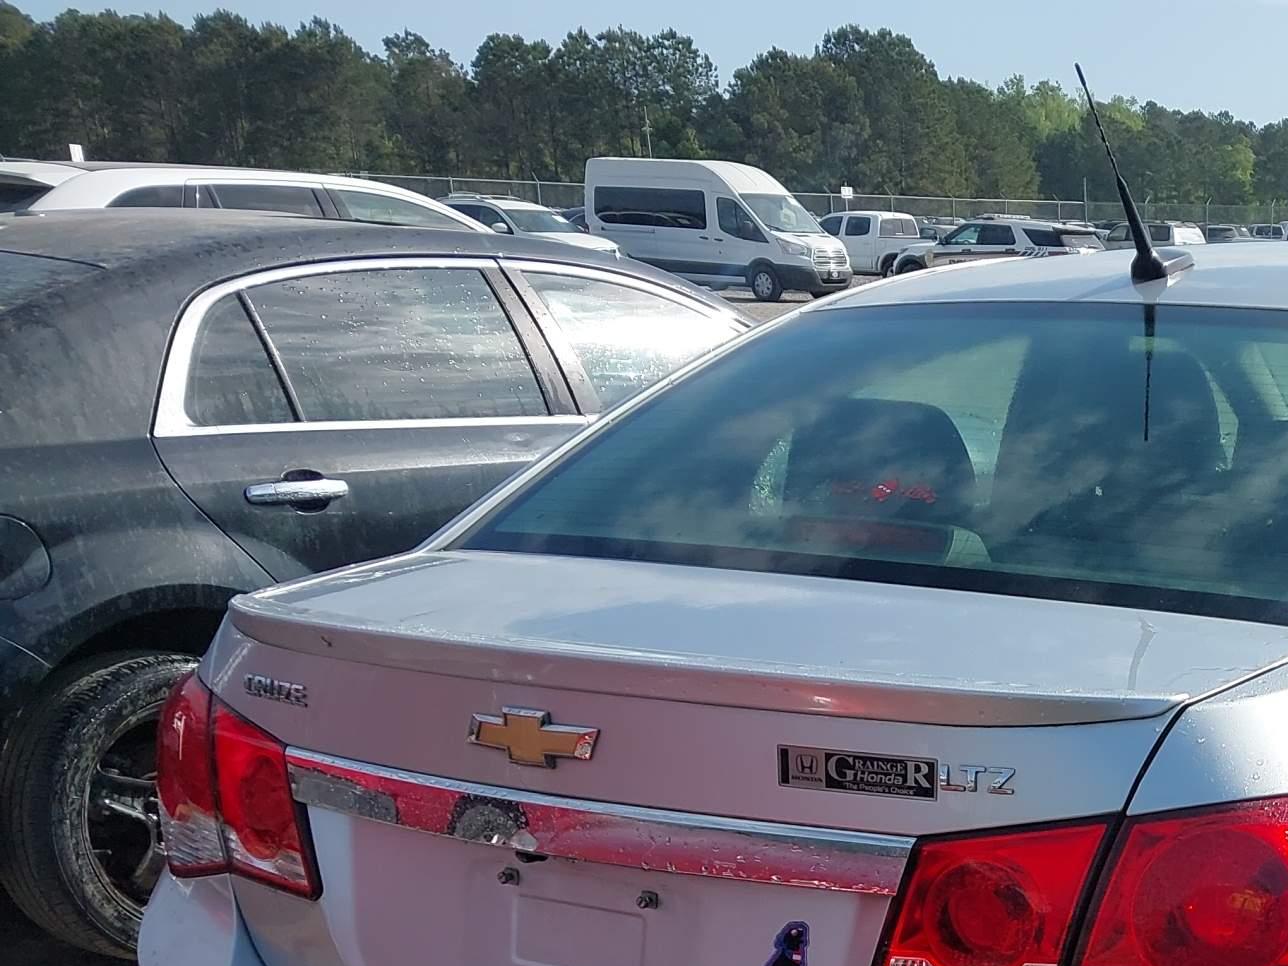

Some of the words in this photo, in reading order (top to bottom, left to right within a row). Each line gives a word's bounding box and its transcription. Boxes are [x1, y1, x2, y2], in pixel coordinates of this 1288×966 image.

[243, 674, 308, 705] CRUZE
[856, 769, 903, 785] Honda
[939, 764, 1016, 796] LTZ
